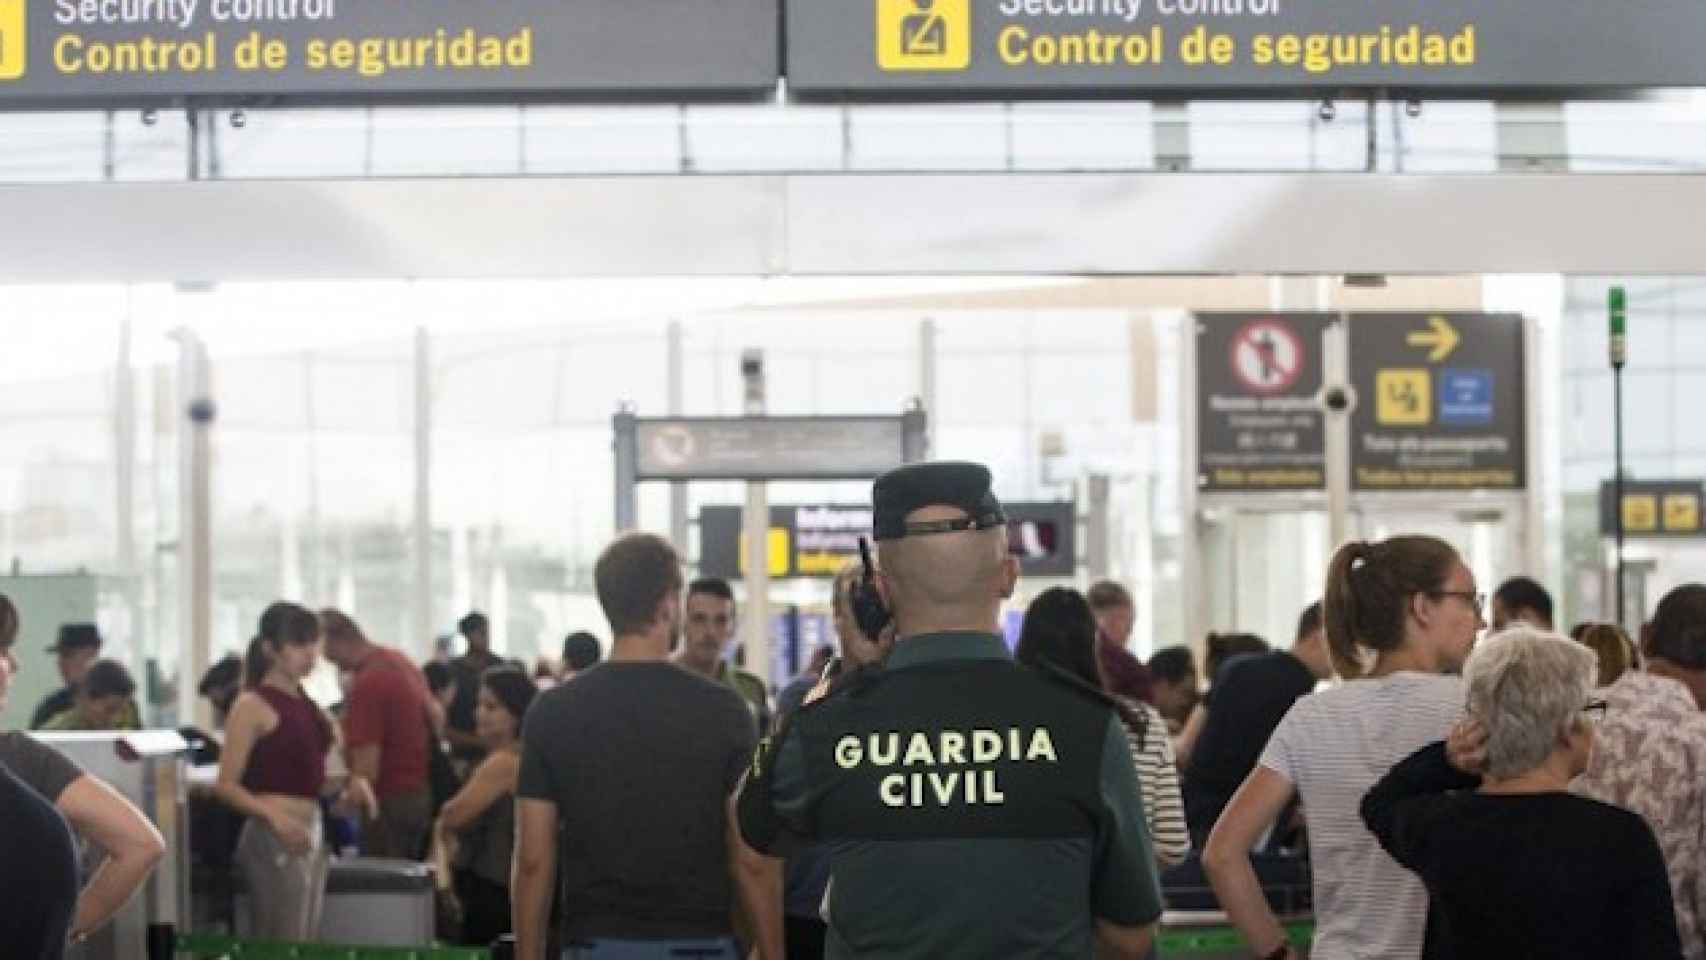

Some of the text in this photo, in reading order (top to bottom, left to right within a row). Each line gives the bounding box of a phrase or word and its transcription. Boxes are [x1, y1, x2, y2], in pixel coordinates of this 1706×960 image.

[53, 0, 336, 27] Security control
[53, 28, 532, 76] Control de seguridad
[997, 23, 1476, 71] Control de seguridad
[834, 727, 1058, 768] GUARDIA
[880, 770, 1004, 807] CIVIL
